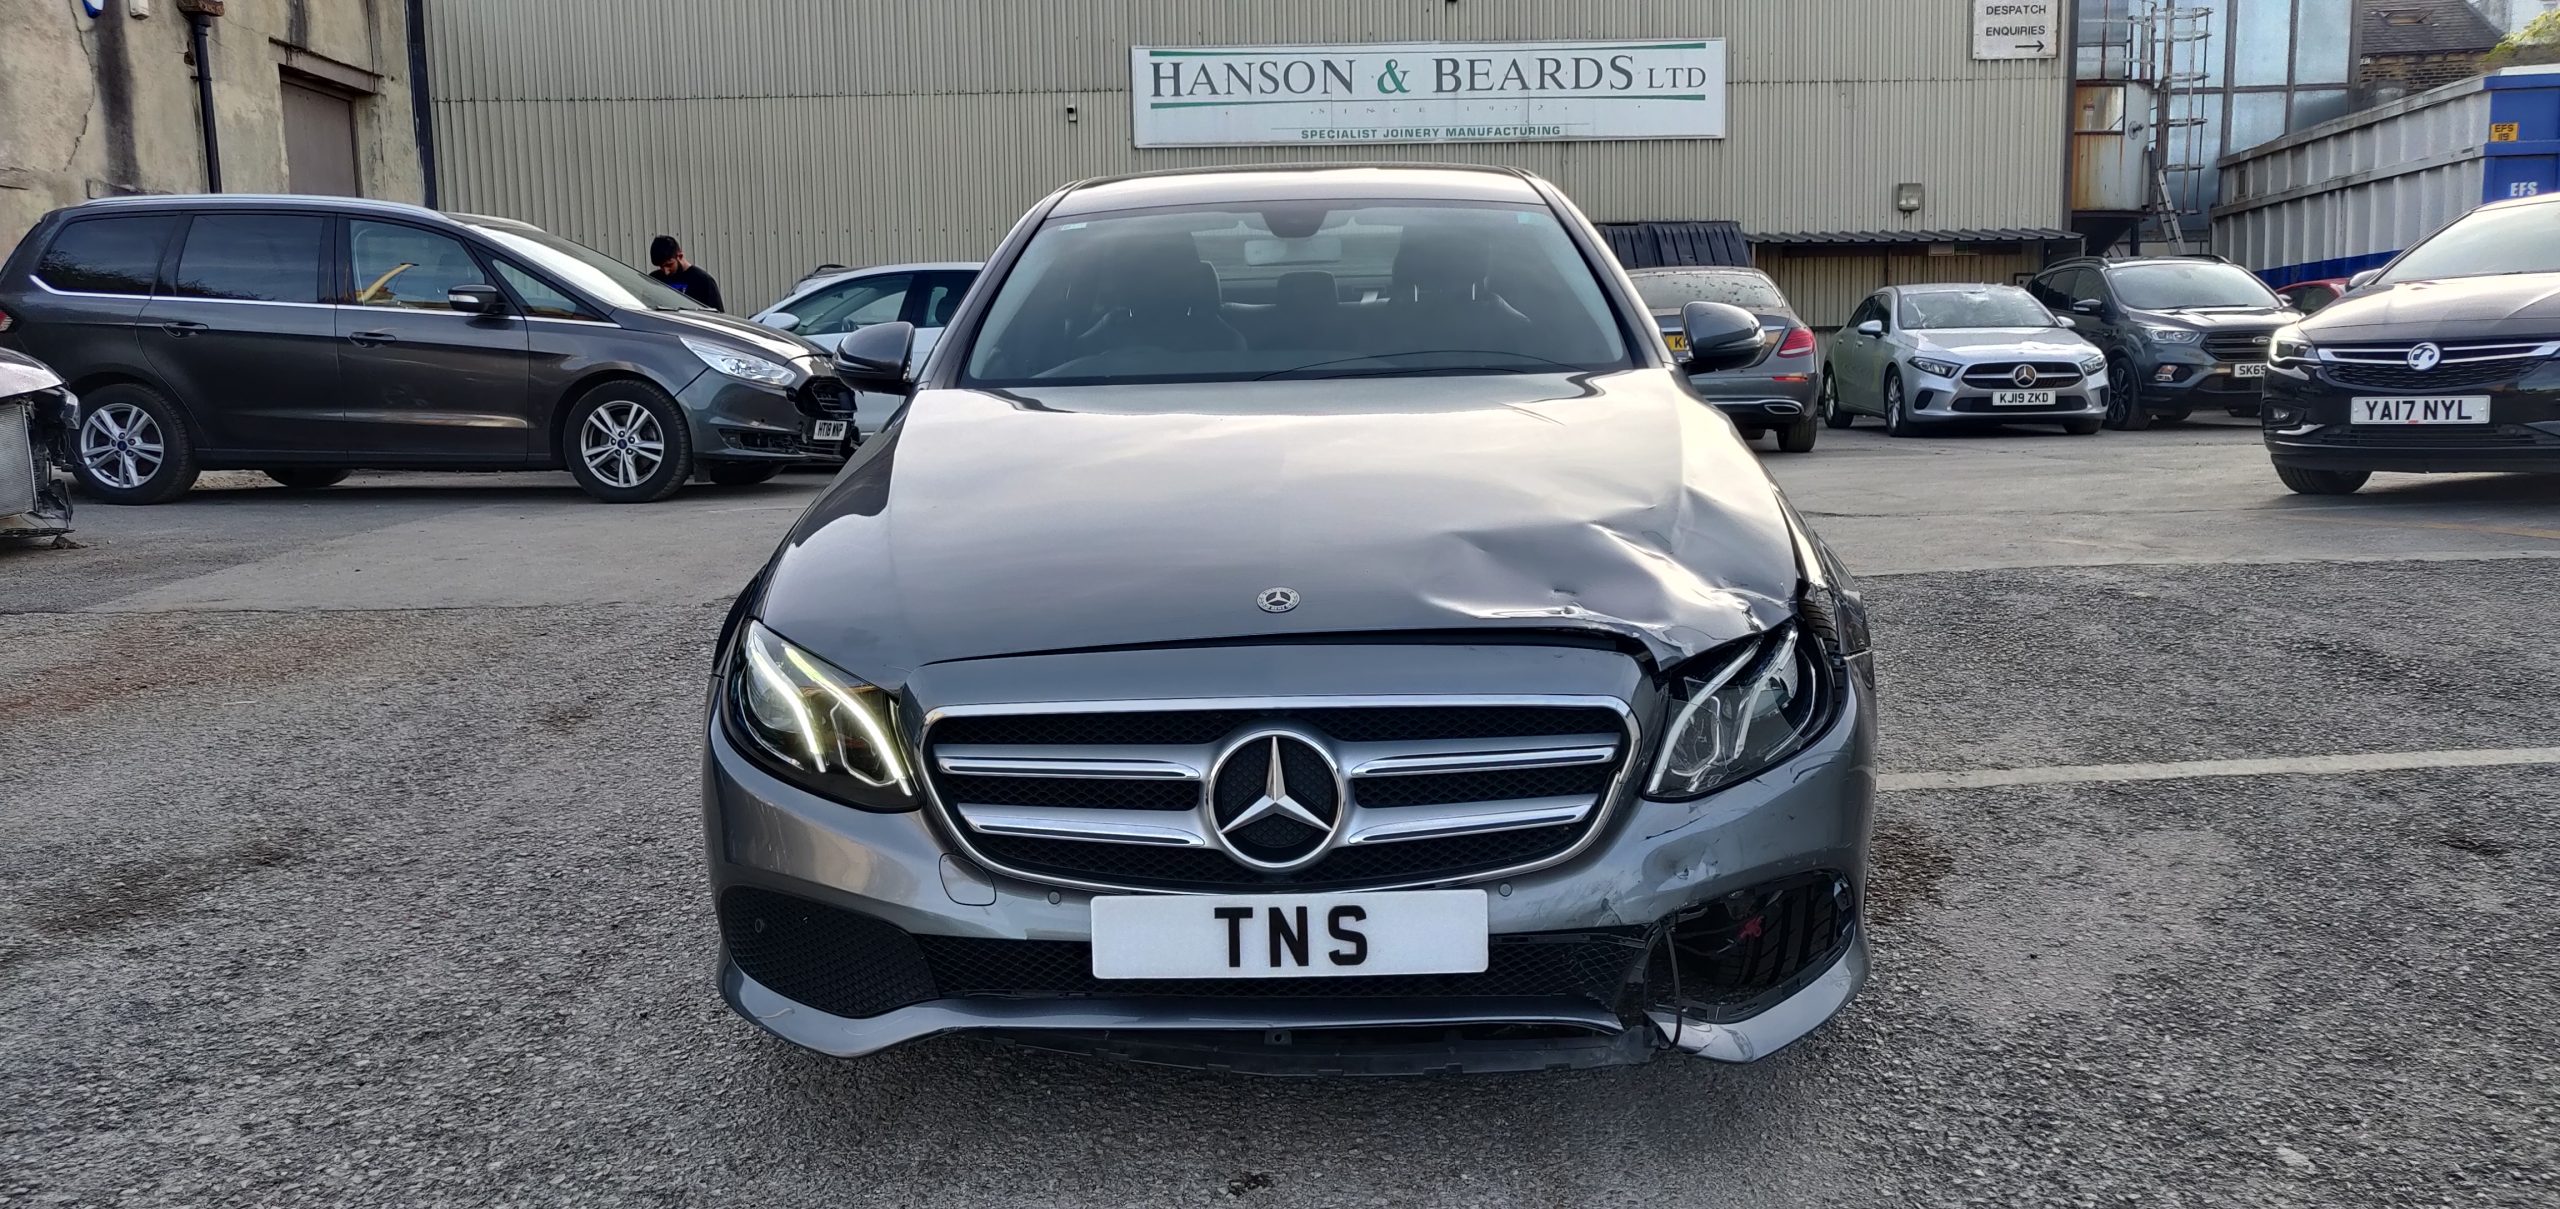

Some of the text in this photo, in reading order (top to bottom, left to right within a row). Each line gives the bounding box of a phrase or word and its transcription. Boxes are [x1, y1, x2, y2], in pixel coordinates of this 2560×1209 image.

[1986, 5, 2046, 15] DESPATCH
[1986, 25, 2046, 36] ENQUIRIES
[1149, 55, 1707, 97] HANSON & BEARDS LTD
[1301, 126, 1561, 139] SPECIALIST JOINERY MANUFACTURING
[2495, 124, 2514, 133] EFS
[2510, 182, 2538, 197] EFS
[2000, 392, 2049, 404] KJ19 ZKD
[2365, 400, 2472, 420] YA17 NYL
[1214, 905, 1368, 967] TNS
